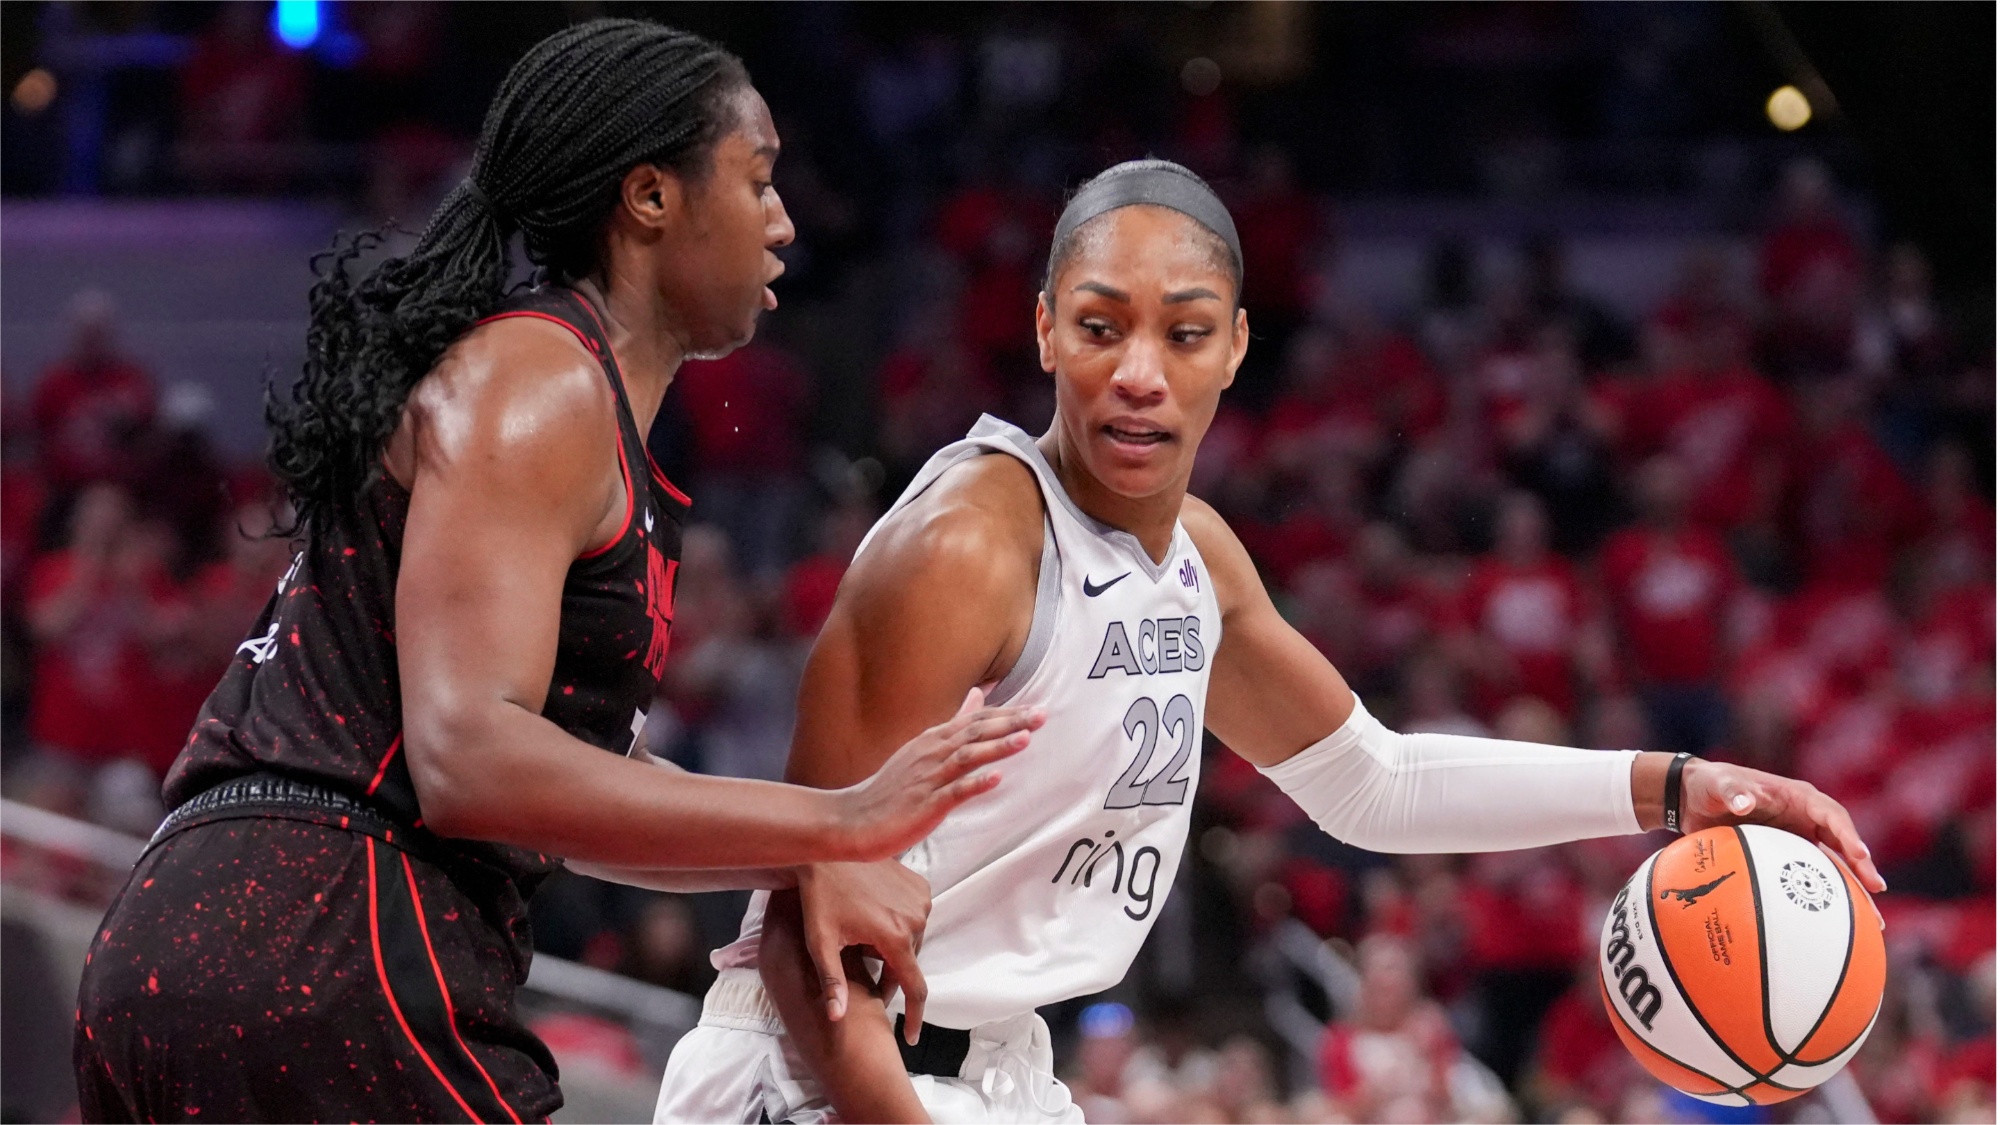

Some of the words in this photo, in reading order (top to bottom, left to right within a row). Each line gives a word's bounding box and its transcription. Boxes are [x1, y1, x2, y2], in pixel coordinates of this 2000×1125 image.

[1179, 558, 1200, 593] ally
[1087, 615, 1205, 679] ACES
[1103, 694, 1195, 810] 22
[1667, 809, 1676, 827] 12:2
[1051, 830, 1161, 921] ring
[1705, 916, 1720, 961] OFFICIAL
[1711, 907, 1722, 934] BALL
[1717, 934, 1731, 966] GAME
